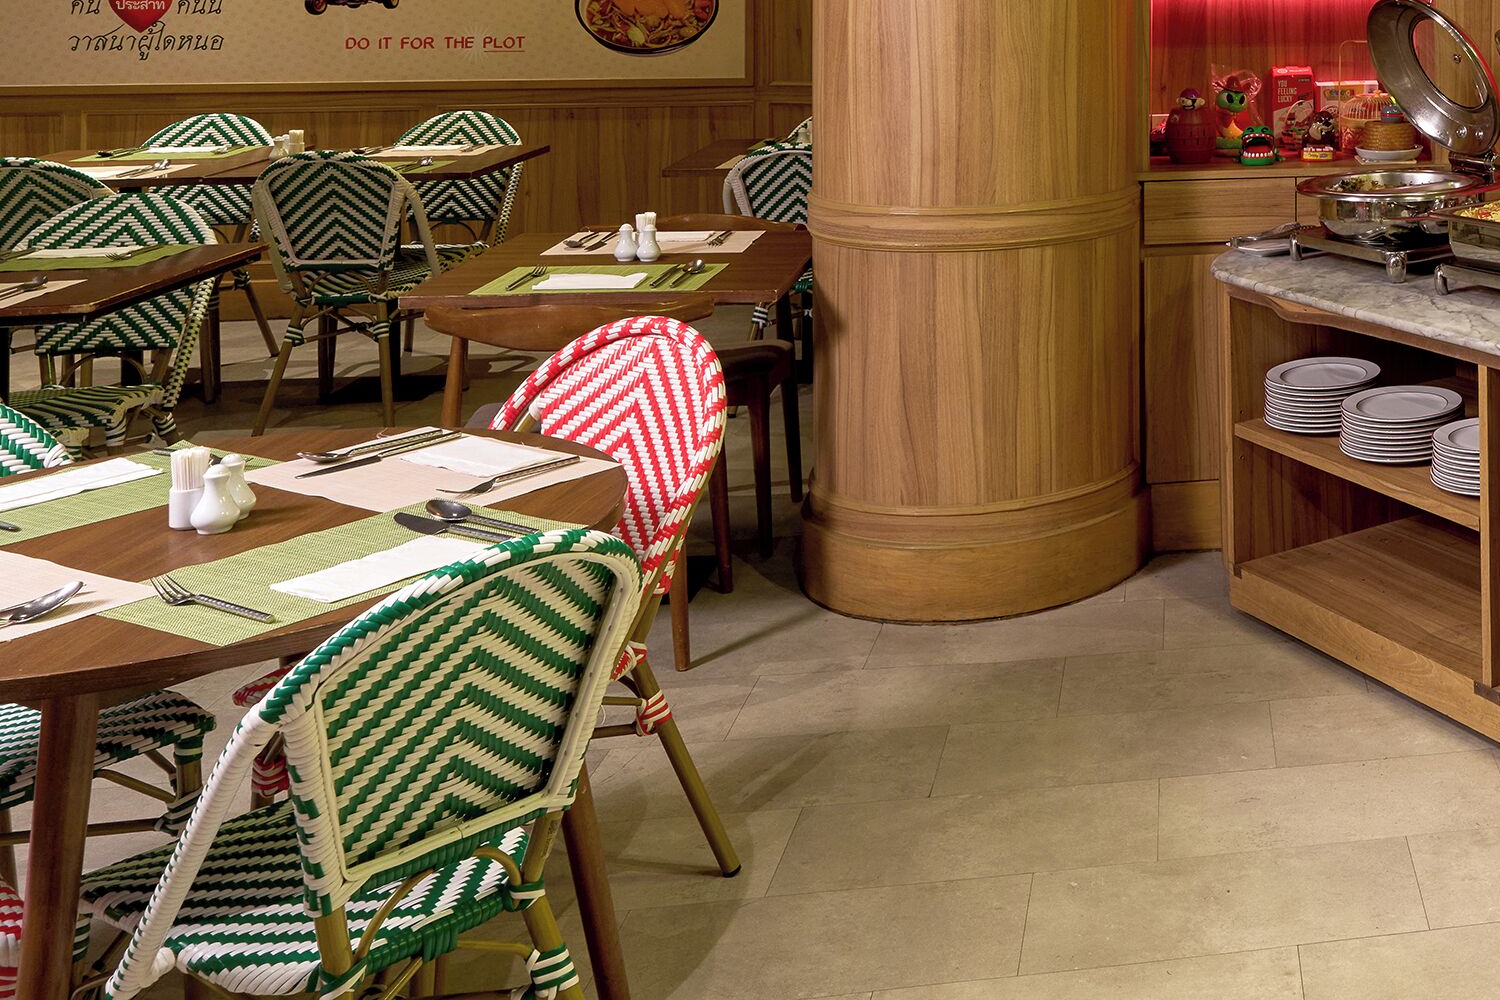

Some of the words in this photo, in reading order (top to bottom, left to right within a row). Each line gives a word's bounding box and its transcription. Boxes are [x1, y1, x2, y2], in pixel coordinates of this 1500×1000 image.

[71, 0, 101, 15] คน
[68, 20, 225, 61] วาสนาผู้ใดหนอ
[345, 37, 370, 50] DO
[378, 37, 392, 50] IT
[400, 37, 435, 50] FOR
[444, 36, 475, 49] THE
[483, 36, 526, 49] PLOT
[1278, 87, 1297, 95] FEELING
